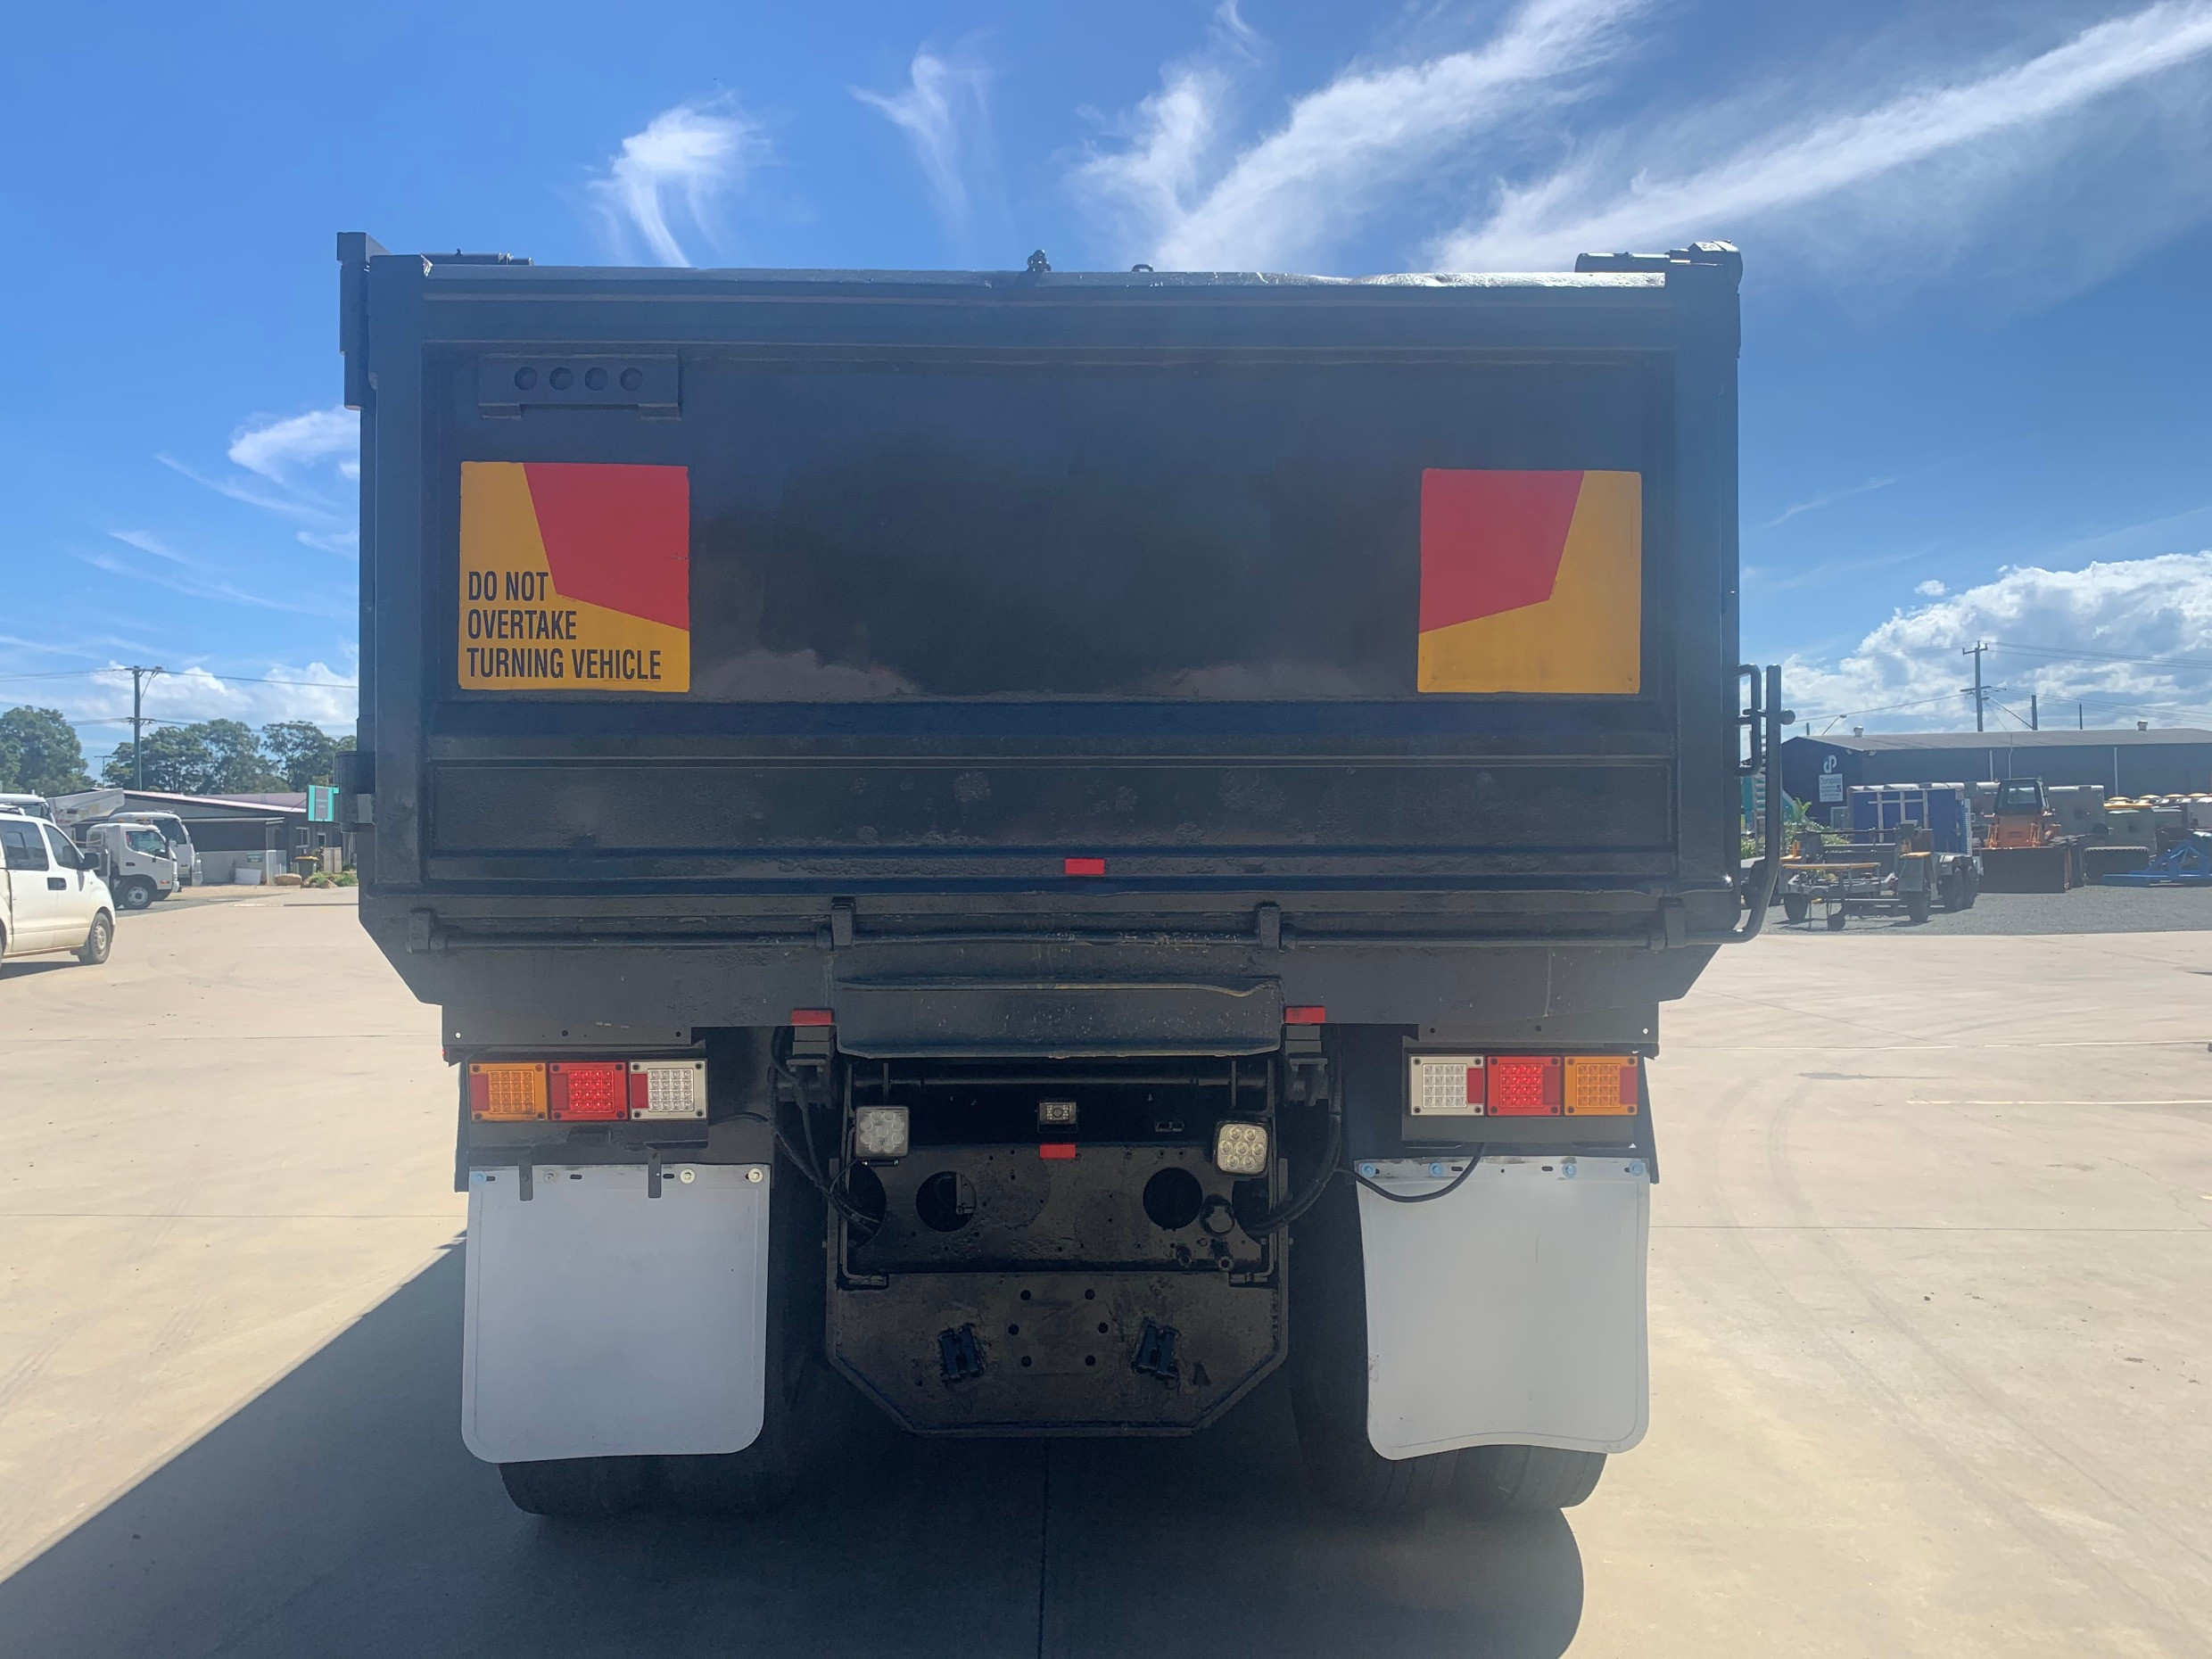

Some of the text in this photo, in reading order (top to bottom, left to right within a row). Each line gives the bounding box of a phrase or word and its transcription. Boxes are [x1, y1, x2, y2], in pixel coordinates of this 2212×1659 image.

[468, 571, 549, 601] DO NOT
[467, 609, 577, 640] OVERTAKE
[466, 648, 661, 679] TURNING VEHICLE
